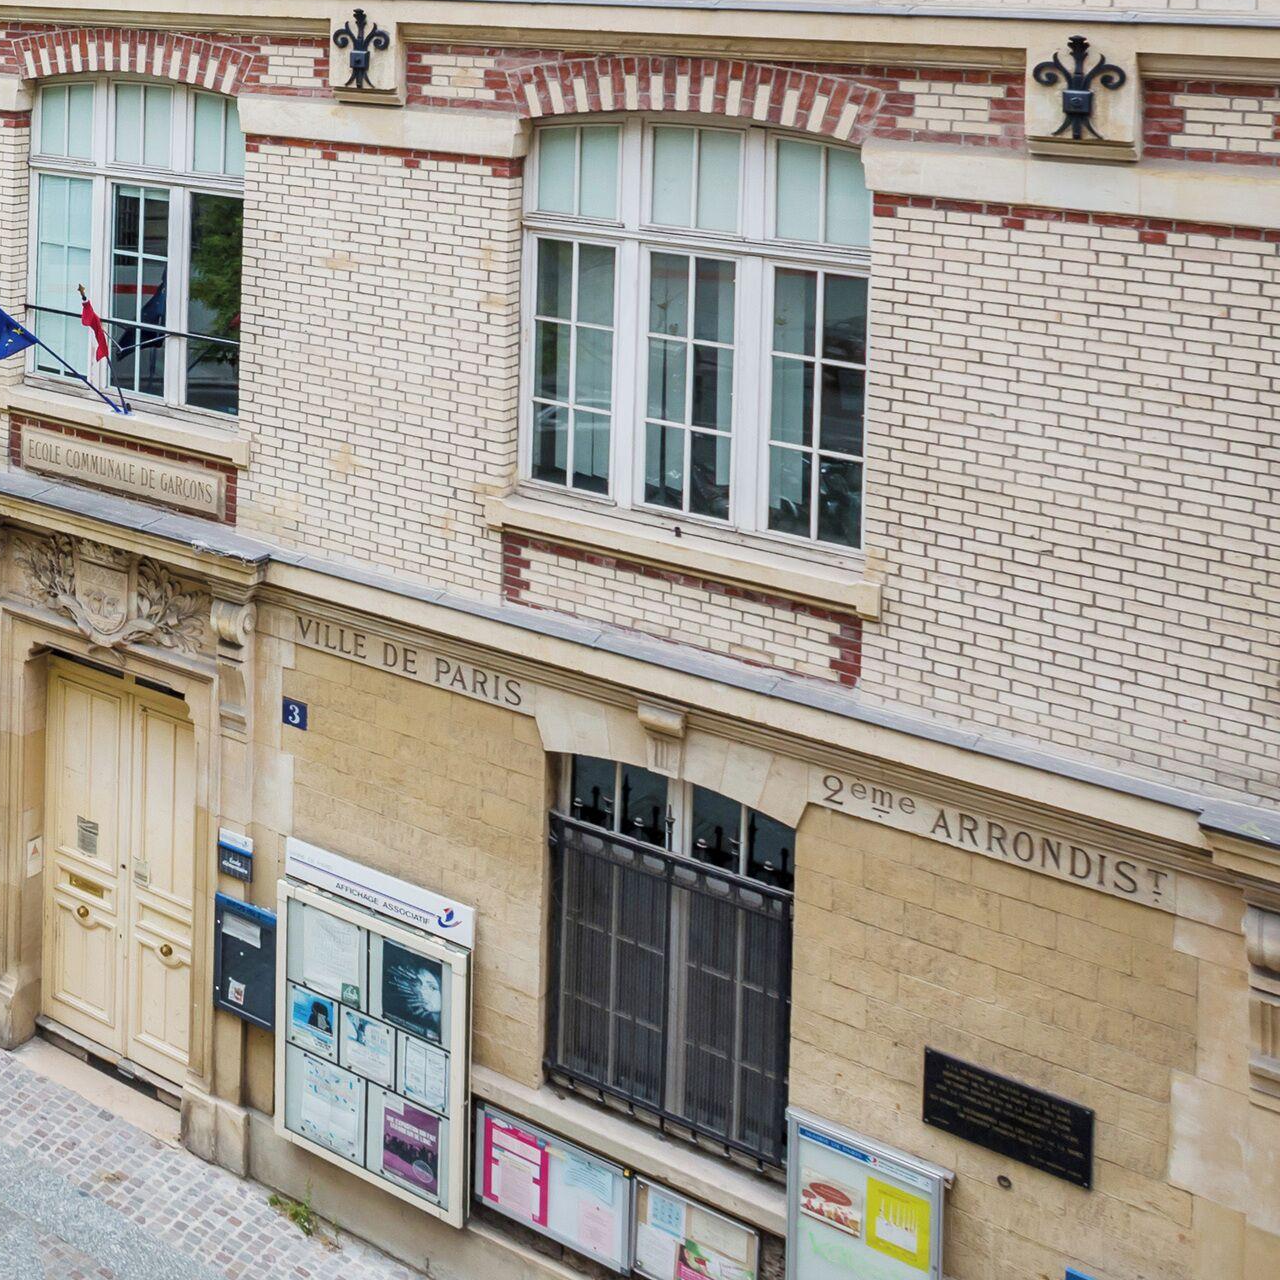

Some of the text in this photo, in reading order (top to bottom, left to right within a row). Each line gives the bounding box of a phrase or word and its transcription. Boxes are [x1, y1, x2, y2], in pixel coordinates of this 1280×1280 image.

[28, 438, 214, 505] ECOLE COMMUNALE DE GARÇONS
[296, 616, 523, 707] VILLE DE PARIS
[288, 704, 301, 725] 3
[821, 774, 917, 819] 2ème
[335, 882, 431, 926] AFFICHAGE ASSOCIATIF
